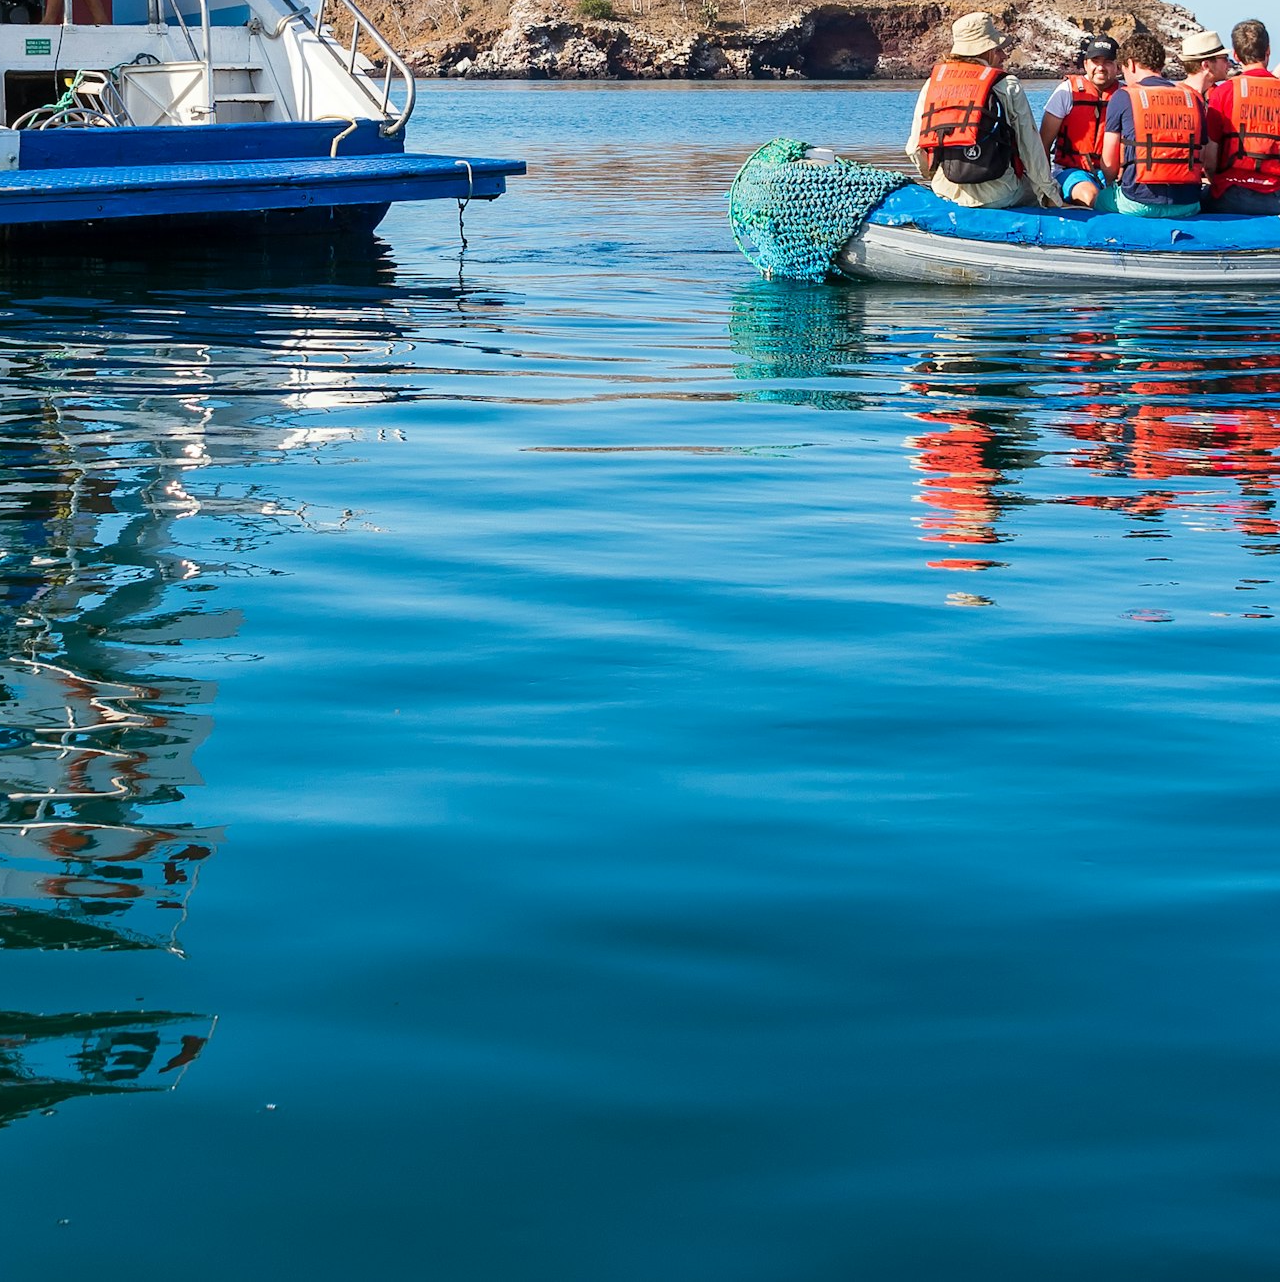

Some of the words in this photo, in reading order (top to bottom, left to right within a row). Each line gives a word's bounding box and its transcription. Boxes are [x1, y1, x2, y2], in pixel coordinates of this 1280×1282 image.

[1249, 85, 1263, 97] PTO
[1151, 95, 1165, 106] PTO
[1166, 95, 1187, 107] AYORA
[1144, 113, 1196, 131] GUANTANAMERA
